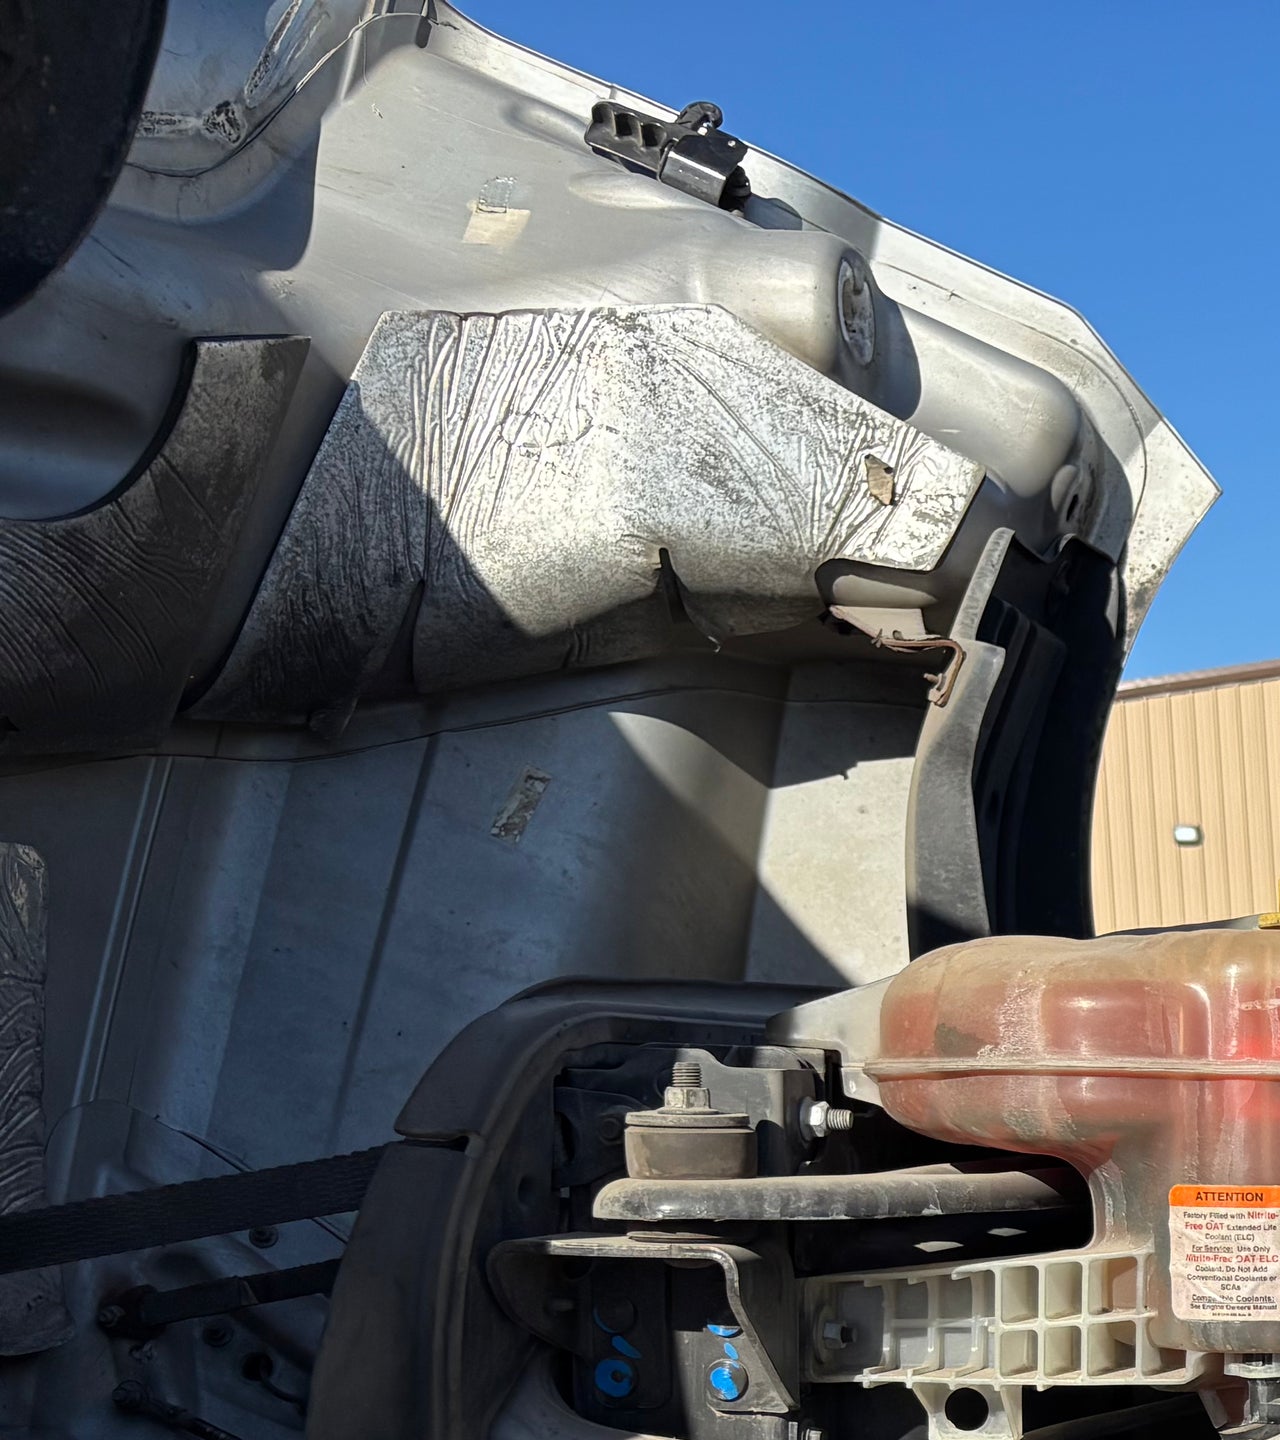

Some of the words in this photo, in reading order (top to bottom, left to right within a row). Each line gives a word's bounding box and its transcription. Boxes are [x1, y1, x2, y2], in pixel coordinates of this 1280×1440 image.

[1195, 1191, 1264, 1202] ATTENTION
[1184, 1211, 1207, 1220] Factory
[1247, 1211, 1279, 1219] Nitrite-
[1185, 1222, 1203, 1230] Free
[1205, 1222, 1225, 1230] OAT
[1234, 1233, 1255, 1241] (ELC)
